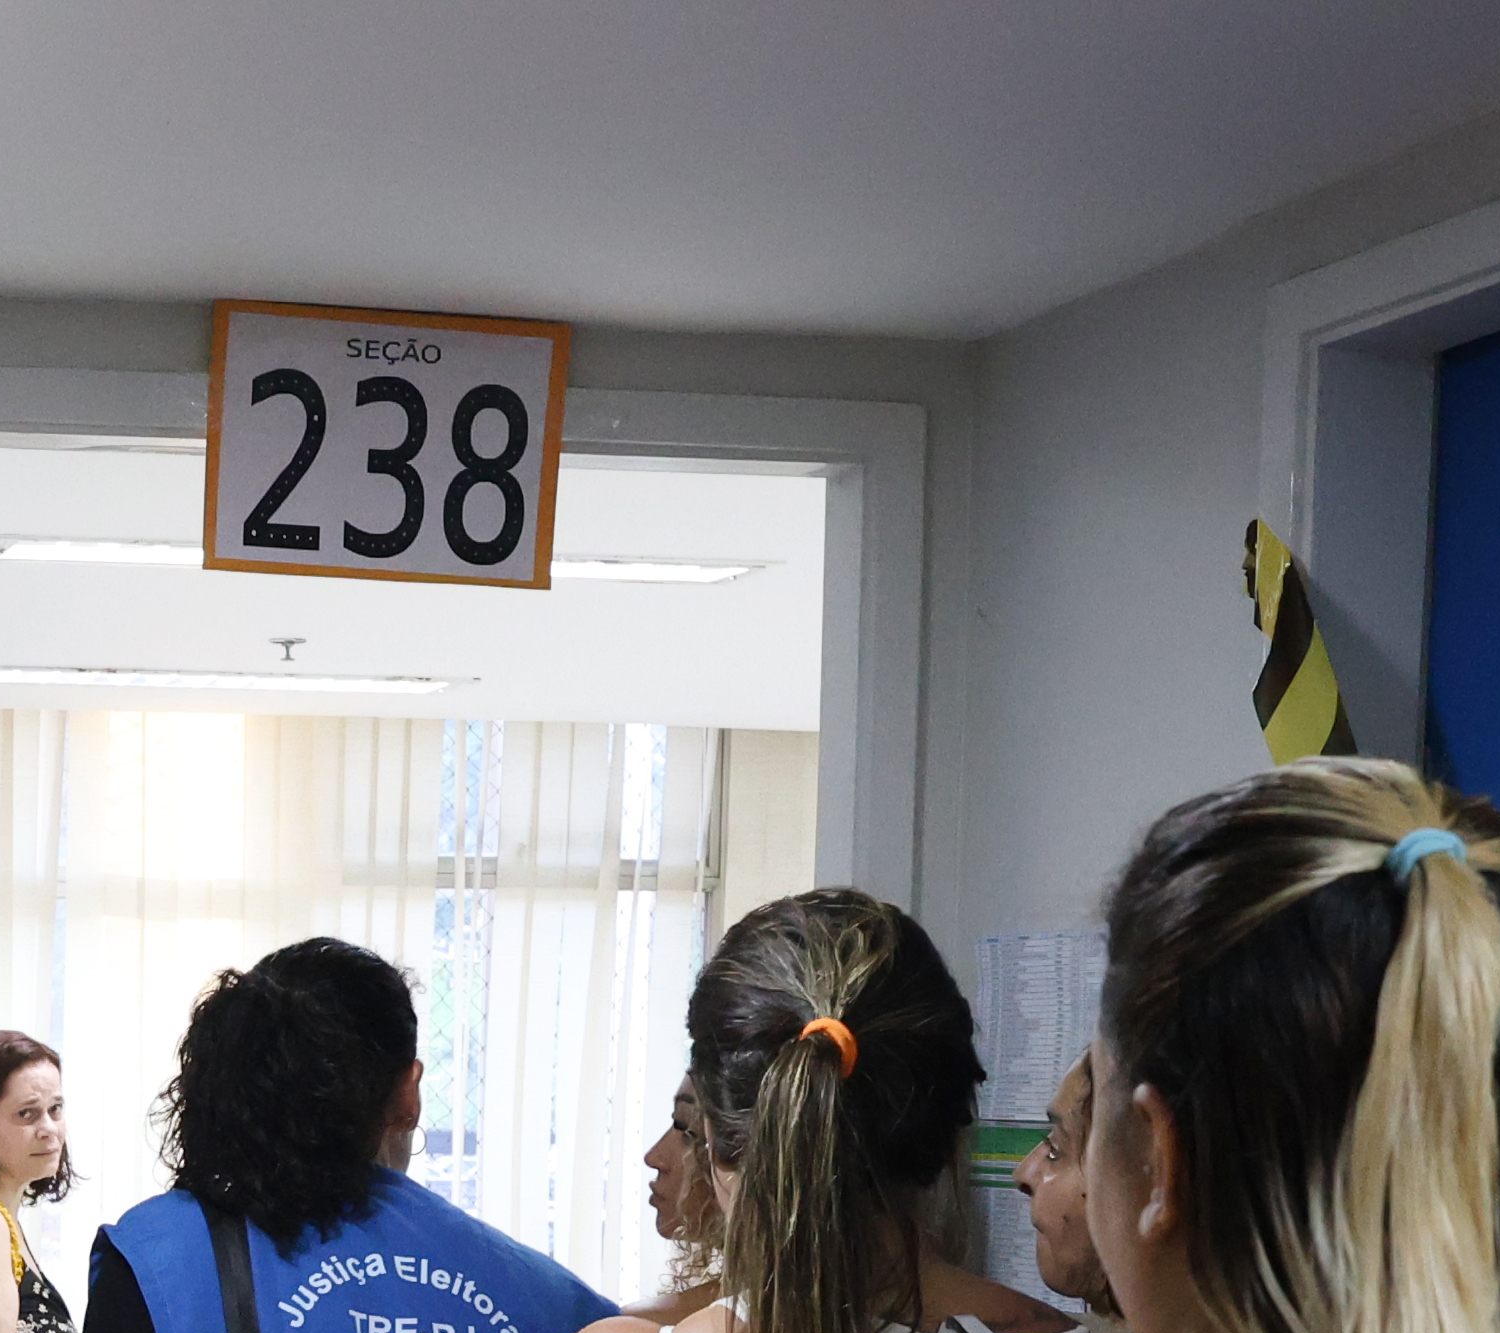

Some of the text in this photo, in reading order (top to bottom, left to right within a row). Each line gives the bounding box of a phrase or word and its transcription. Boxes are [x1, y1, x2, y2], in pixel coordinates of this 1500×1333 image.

[346, 338, 442, 365] SEÇÃO
[242, 367, 529, 566] 238
[277, 1253, 387, 1329] Justiça
